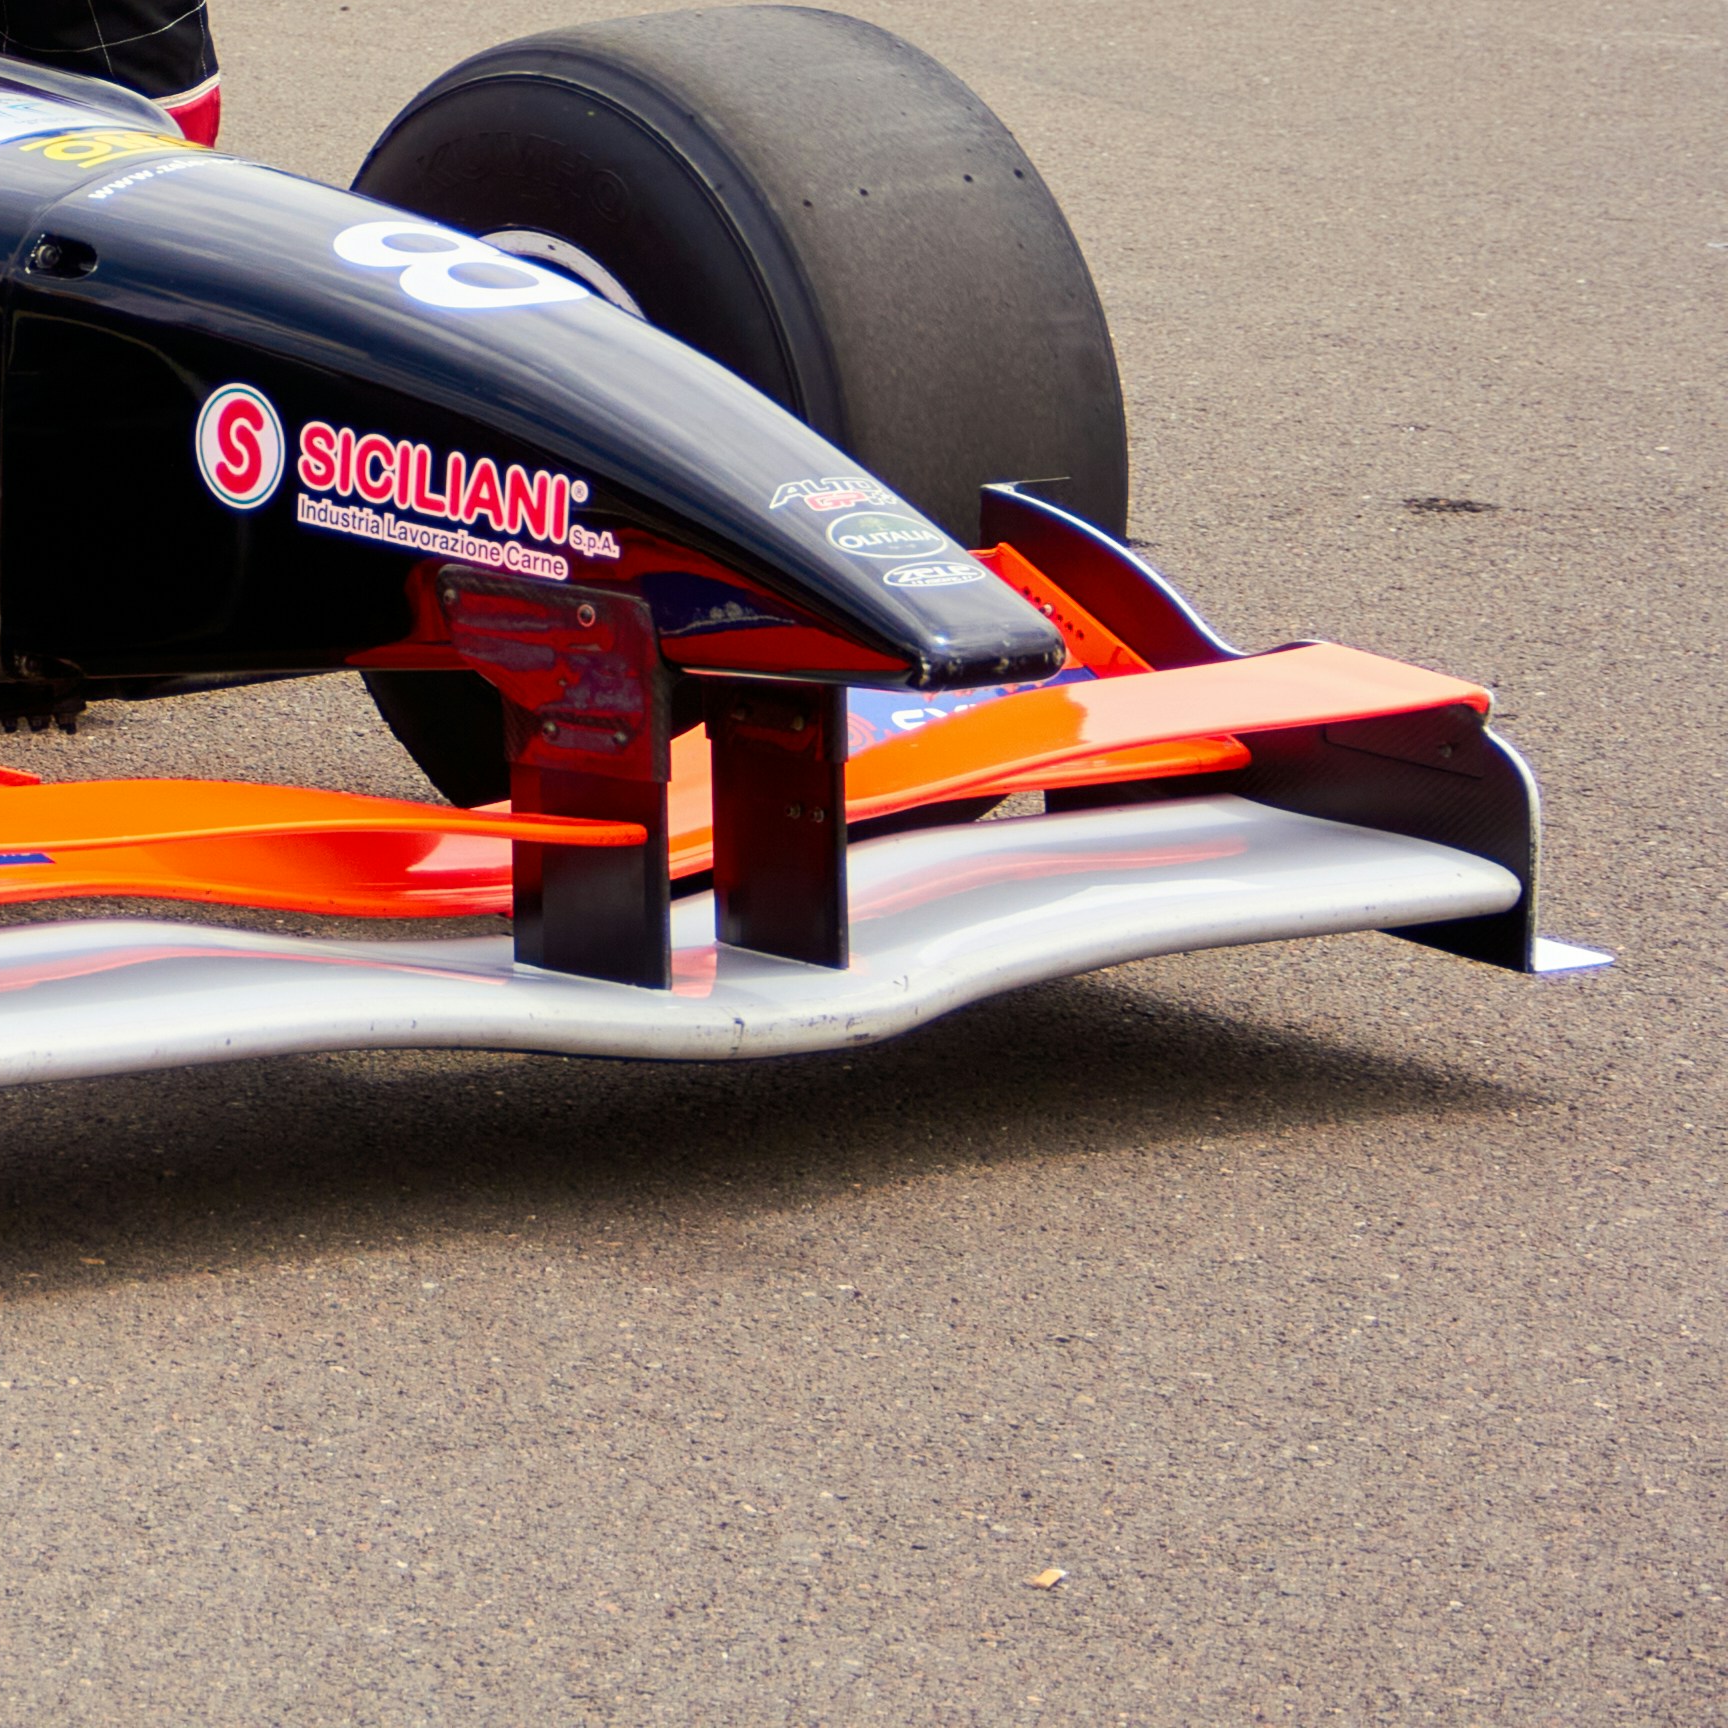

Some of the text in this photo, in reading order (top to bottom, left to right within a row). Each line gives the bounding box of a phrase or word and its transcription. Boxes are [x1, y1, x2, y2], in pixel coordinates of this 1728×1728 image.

[333, 221, 591, 309] 8
[215, 398, 264, 494] S
[299, 424, 568, 543] SICILIANI
[770, 478, 881, 508] AUTO
[806, 492, 866, 511] GP
[299, 499, 566, 577] Industria Lavorazione Carne
[838, 530, 939, 549] OLITALIA
